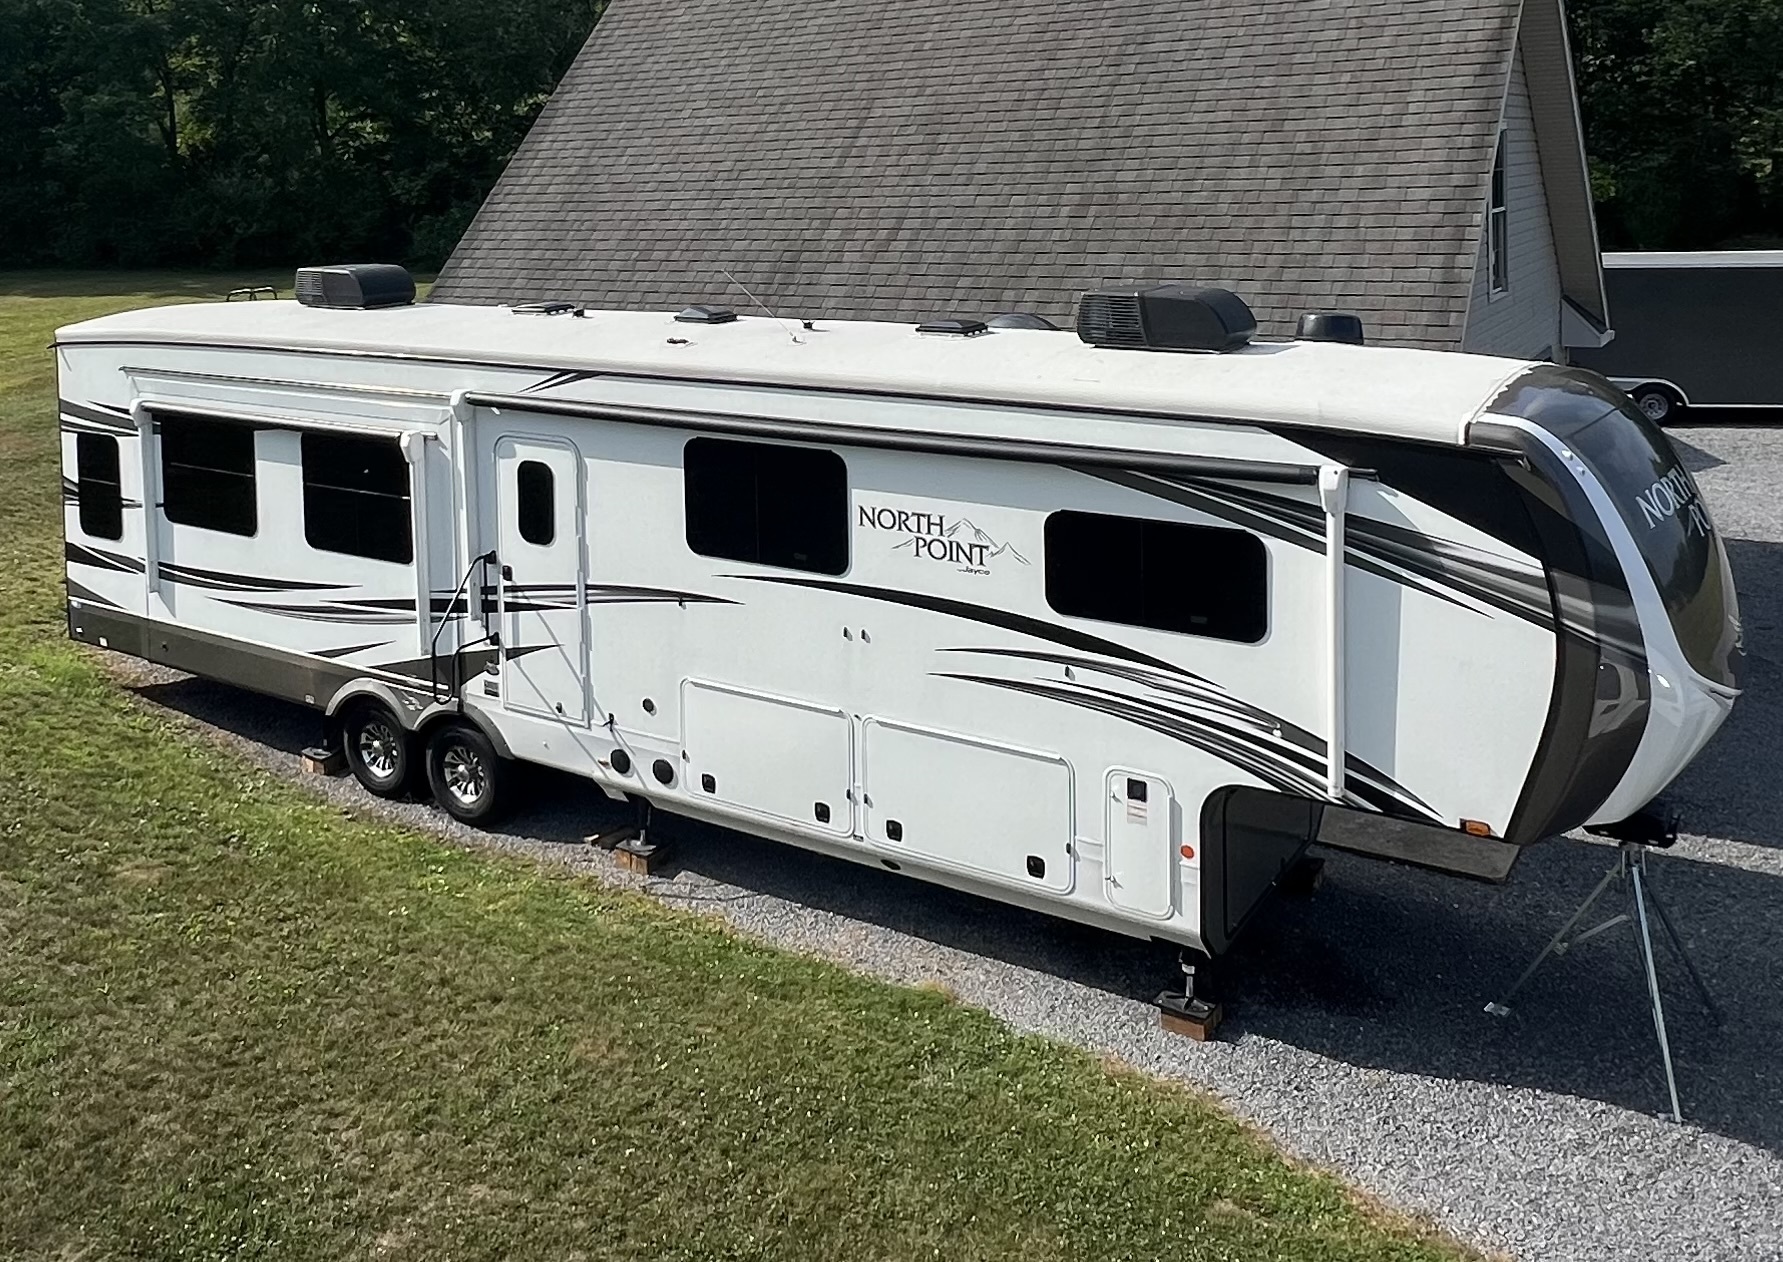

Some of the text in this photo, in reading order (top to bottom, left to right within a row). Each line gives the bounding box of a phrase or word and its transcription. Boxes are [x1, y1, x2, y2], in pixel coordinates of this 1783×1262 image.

[1635, 464, 1693, 530] NORTH
[858, 505, 945, 536] NORTH
[914, 537, 990, 567] POINT
[961, 567, 991, 576] Jayco
